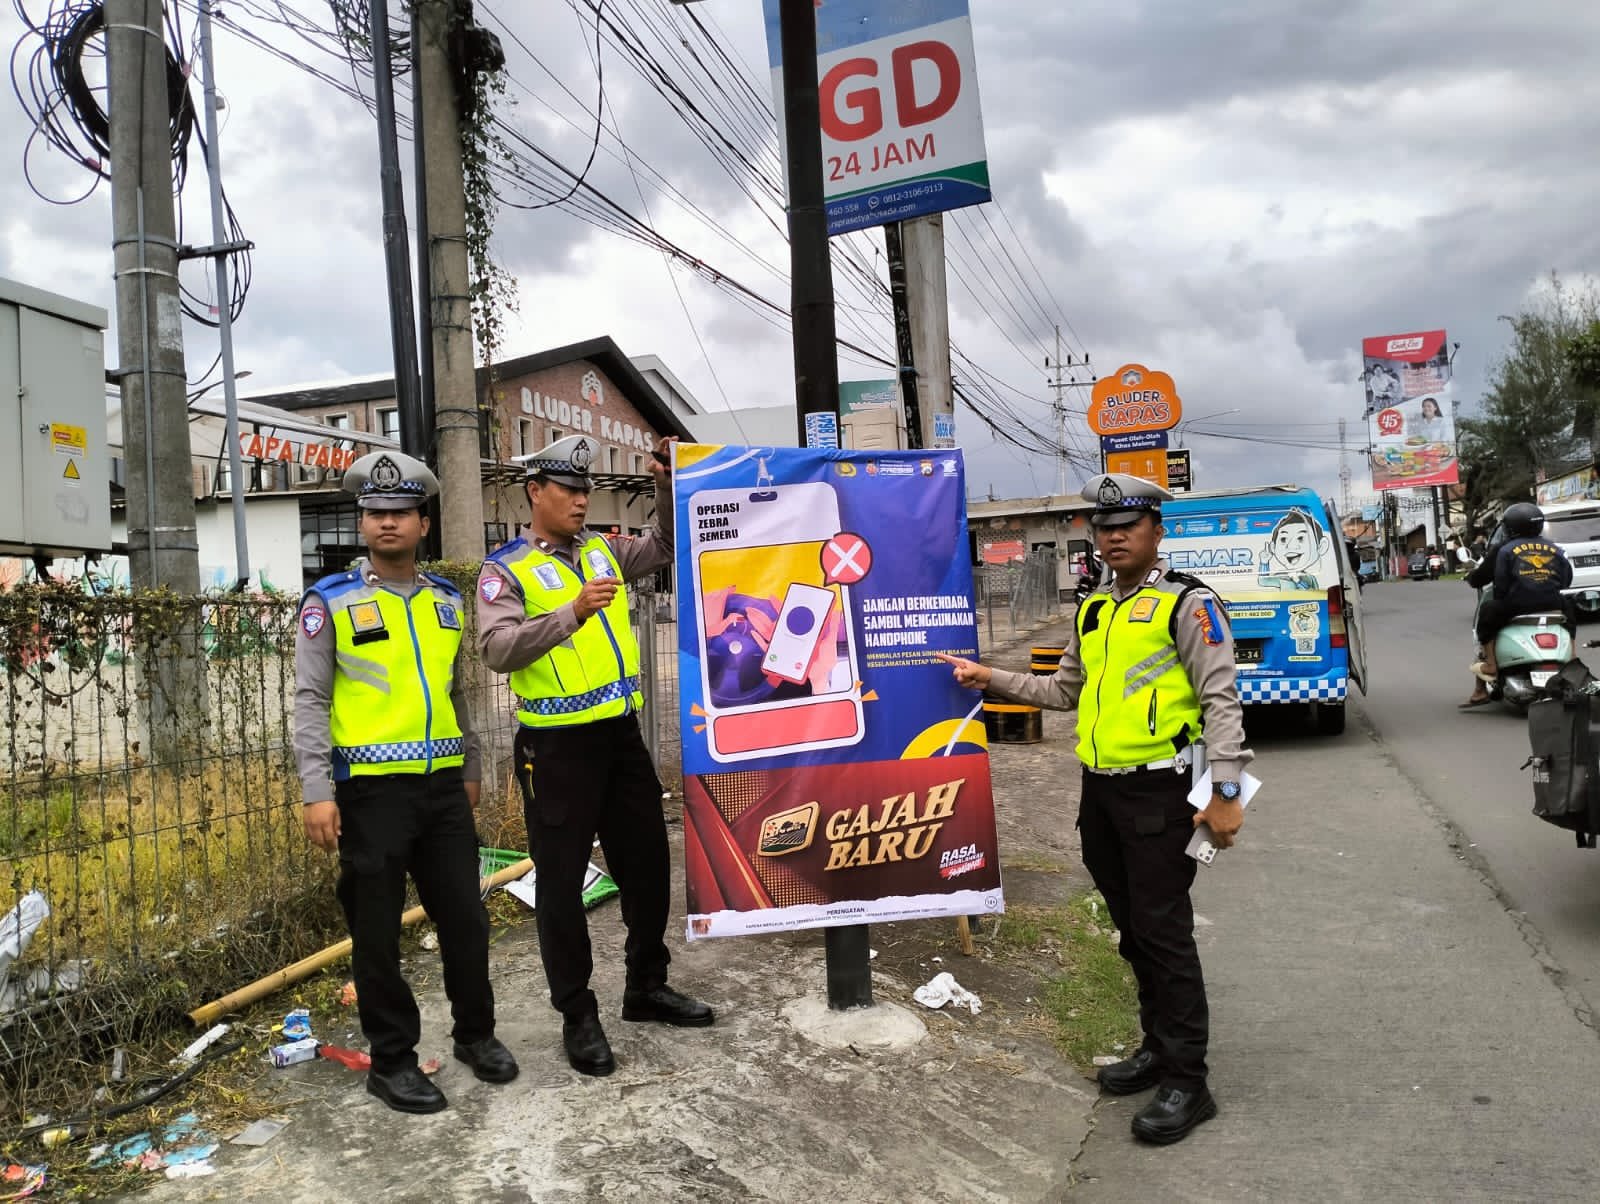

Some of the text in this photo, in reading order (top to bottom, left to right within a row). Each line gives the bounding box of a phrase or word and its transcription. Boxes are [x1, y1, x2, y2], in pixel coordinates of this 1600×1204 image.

[818, 40, 961, 142] GD
[827, 132, 936, 182] 24 JAM
[1106, 390, 1161, 408] BLUDER
[520, 386, 654, 453] BLUDER KAPAS
[1099, 402, 1170, 429] KAPAS
[696, 502, 740, 516] OPERASI
[698, 517, 729, 529] ZEBRA
[699, 529, 739, 543] SEMERU
[863, 595, 969, 613] JANGAN BERKENDARA
[864, 612, 974, 630] SAMBIL MENGGUNAKAN
[865, 630, 928, 648] HANDPHONE
[824, 777, 966, 842] GAJAH
[823, 822, 944, 872] BARU
[940, 842, 976, 865] RASA
[826, 907, 865, 916] PERINGATAN
